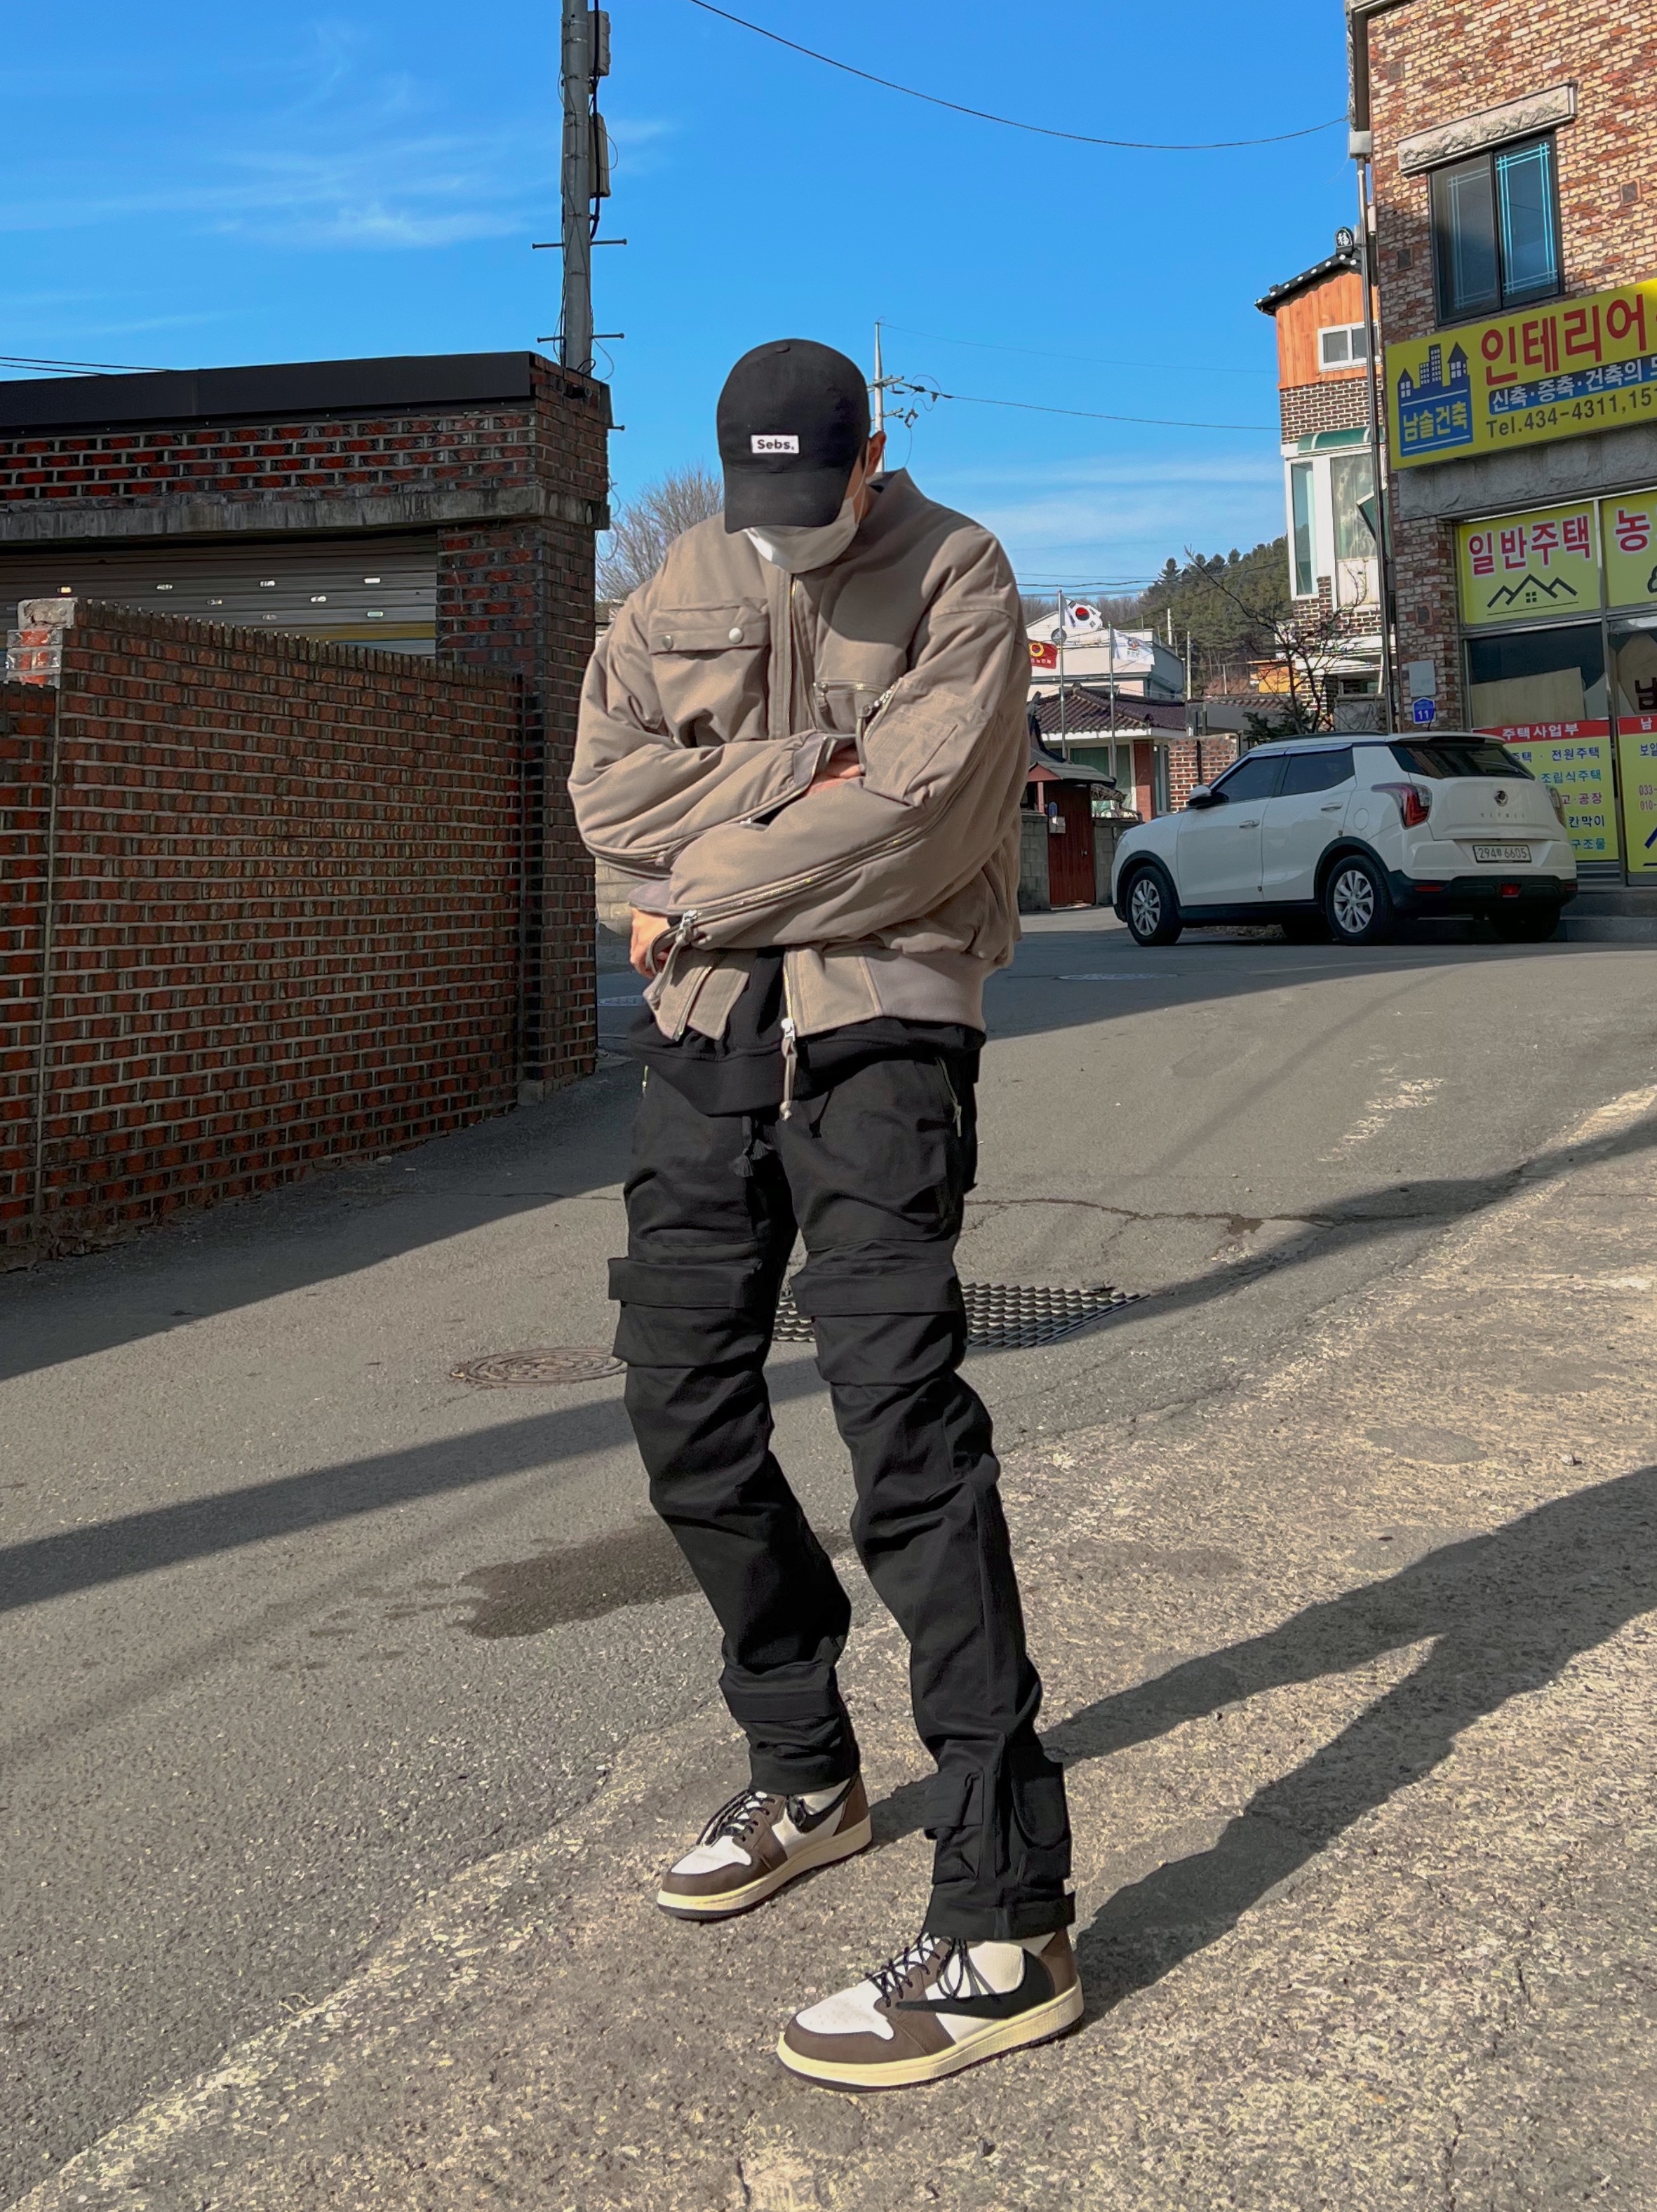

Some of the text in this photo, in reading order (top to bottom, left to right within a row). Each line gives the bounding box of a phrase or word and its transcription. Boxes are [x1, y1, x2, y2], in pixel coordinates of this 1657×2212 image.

[1481, 293, 1647, 386] 인테리어
[1486, 387, 1657, 438] Tel.434-4311,15
[1403, 400, 1468, 442] 남솔건축
[757, 438, 794, 450] Sebs.
[1469, 515, 1590, 575] 일반주택
[1418, 710, 1429, 720] 11
[1502, 722, 1579, 743] 주택사업부
[1551, 746, 1600, 762] 전원주택
[1541, 769, 1602, 784] 조립식주택
[1568, 814, 1605, 828] 칸막이
[1504, 847, 1527, 858] 6605
